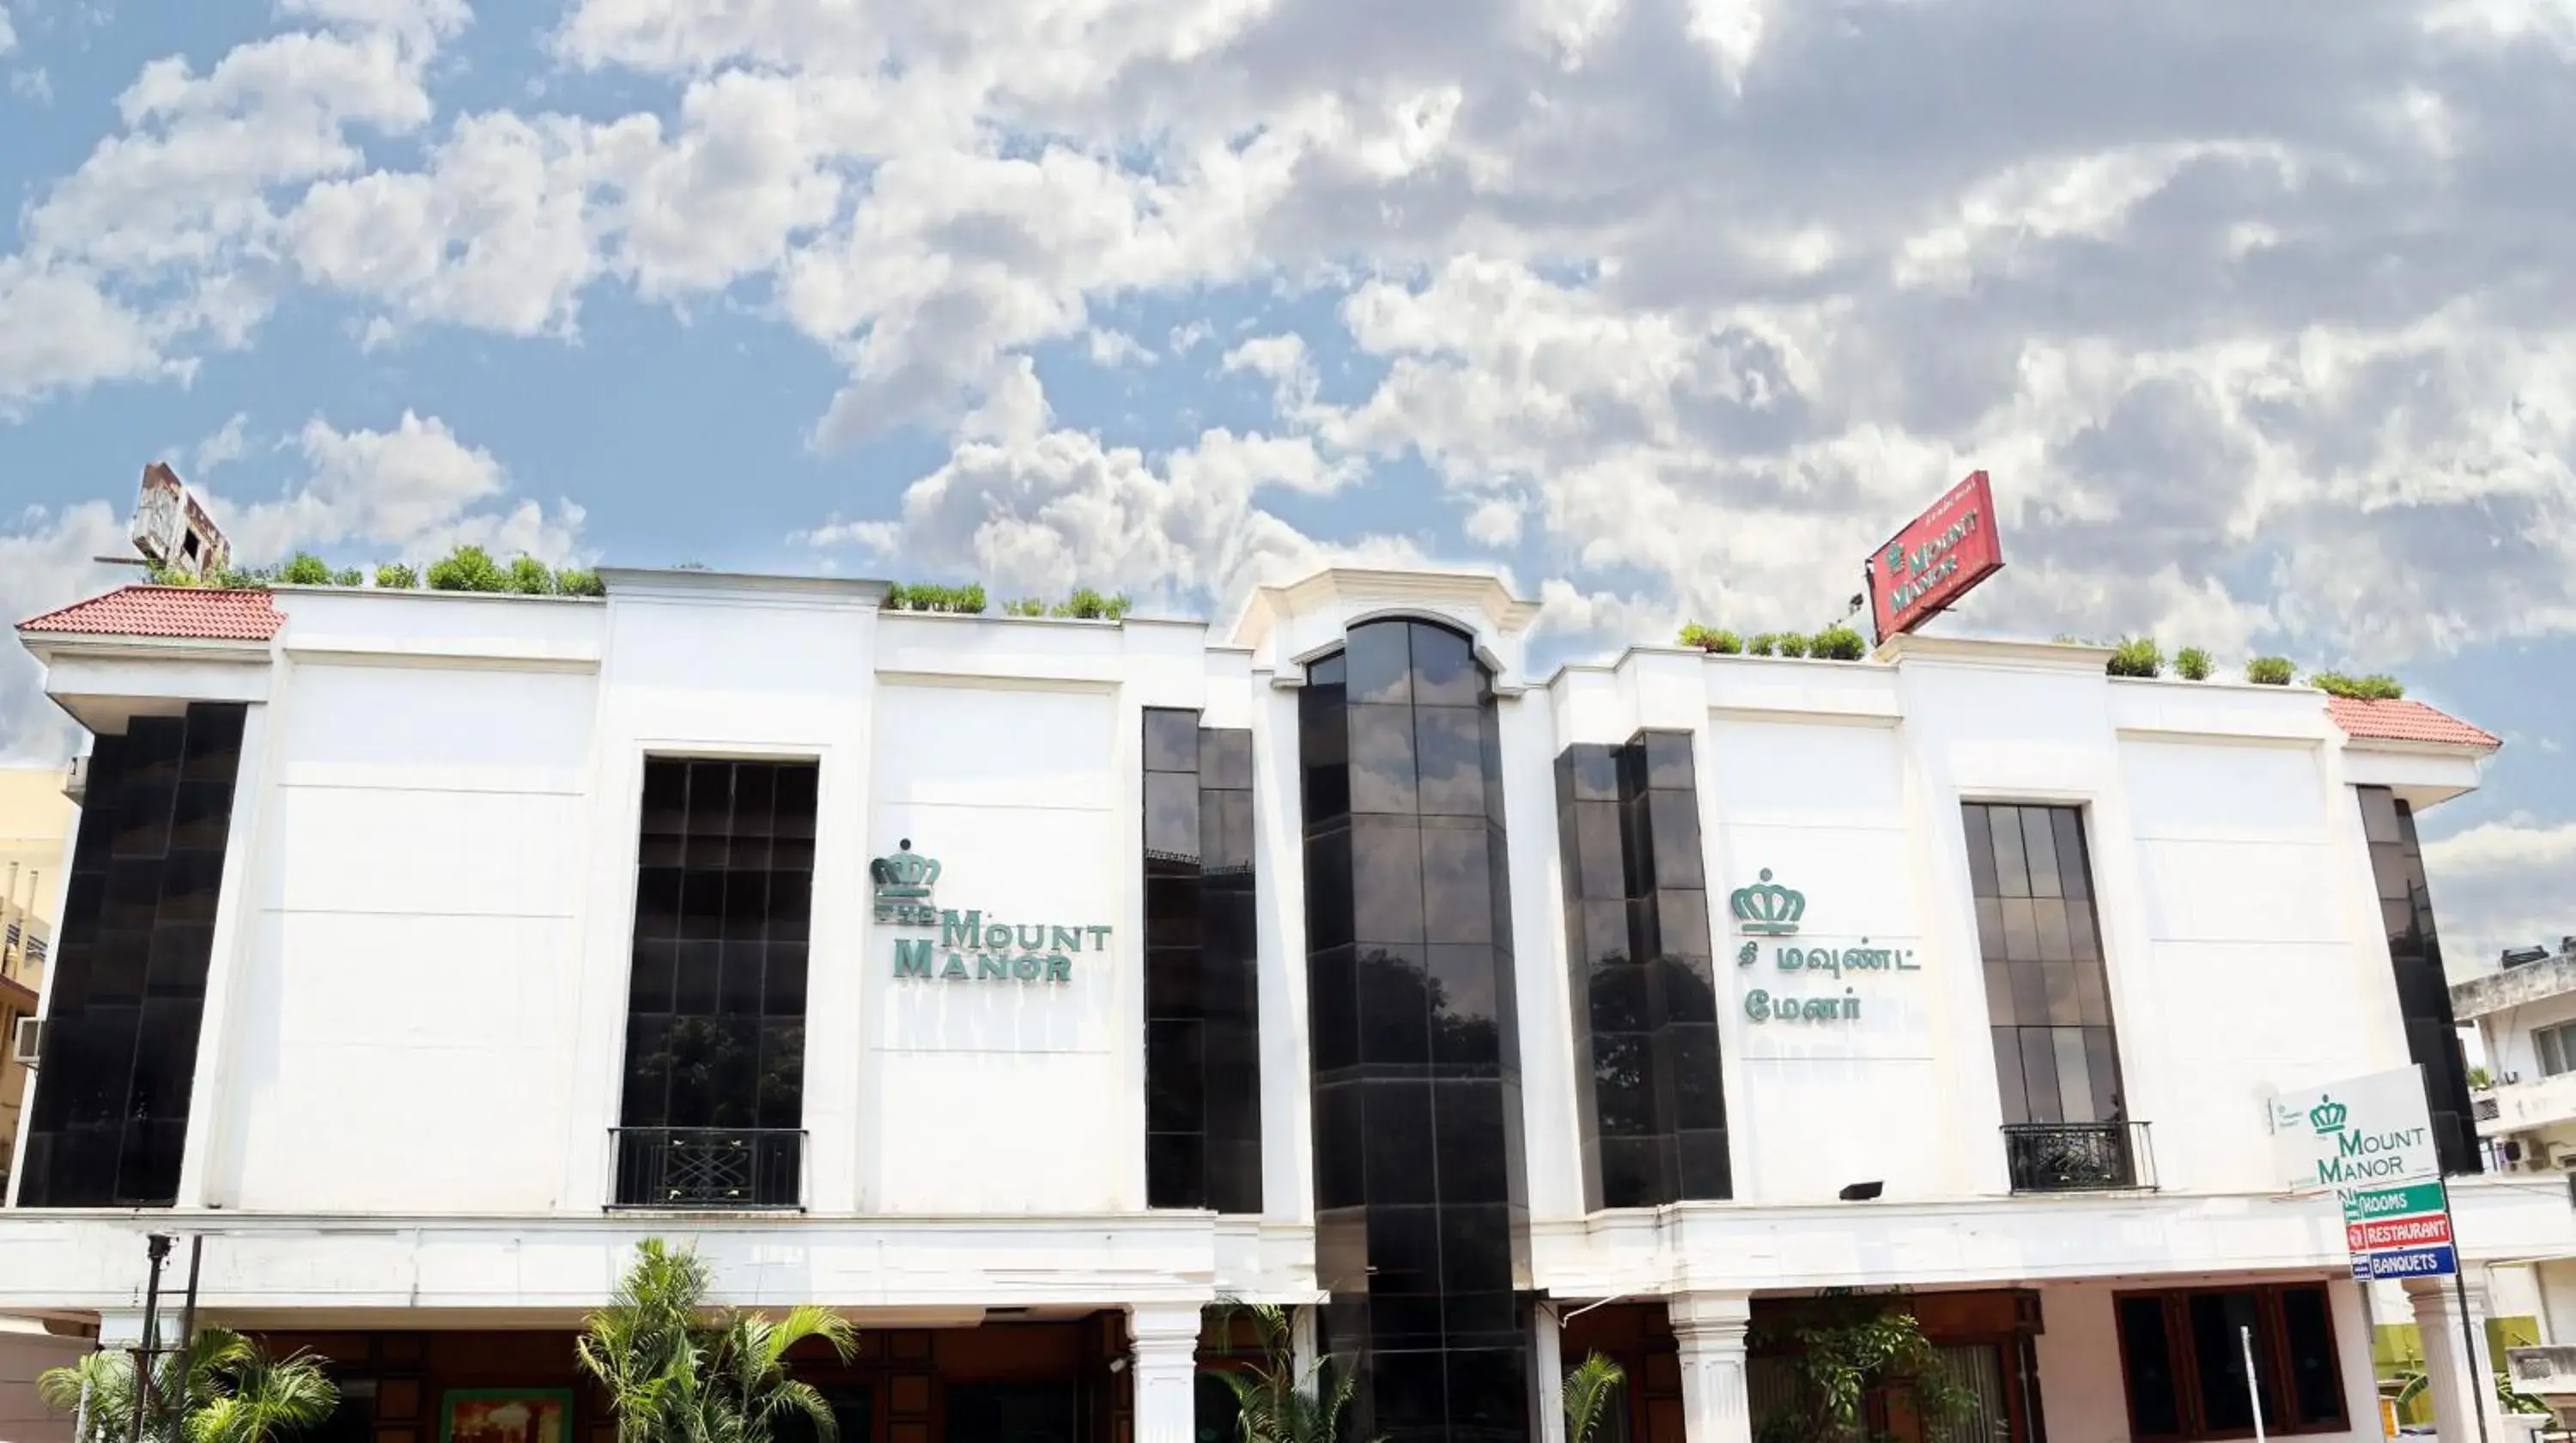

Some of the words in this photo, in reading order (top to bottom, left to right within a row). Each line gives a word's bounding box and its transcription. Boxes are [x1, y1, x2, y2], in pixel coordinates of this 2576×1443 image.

[1909, 508, 1978, 578] MOUNT
[1892, 555, 1958, 614] MANOR
[941, 909, 1113, 952] MOUNT
[893, 939, 1072, 982] MANOR
[1776, 936, 1922, 980] மவுண்ட்
[1744, 987, 1862, 1023] மேனர்
[2338, 1127, 2426, 1158] MOUNT
[2317, 1155, 2405, 1185] MANOR
[2367, 1220, 2447, 1244] RESTAURANT
[2372, 1253, 2439, 1274] BANQUETS
